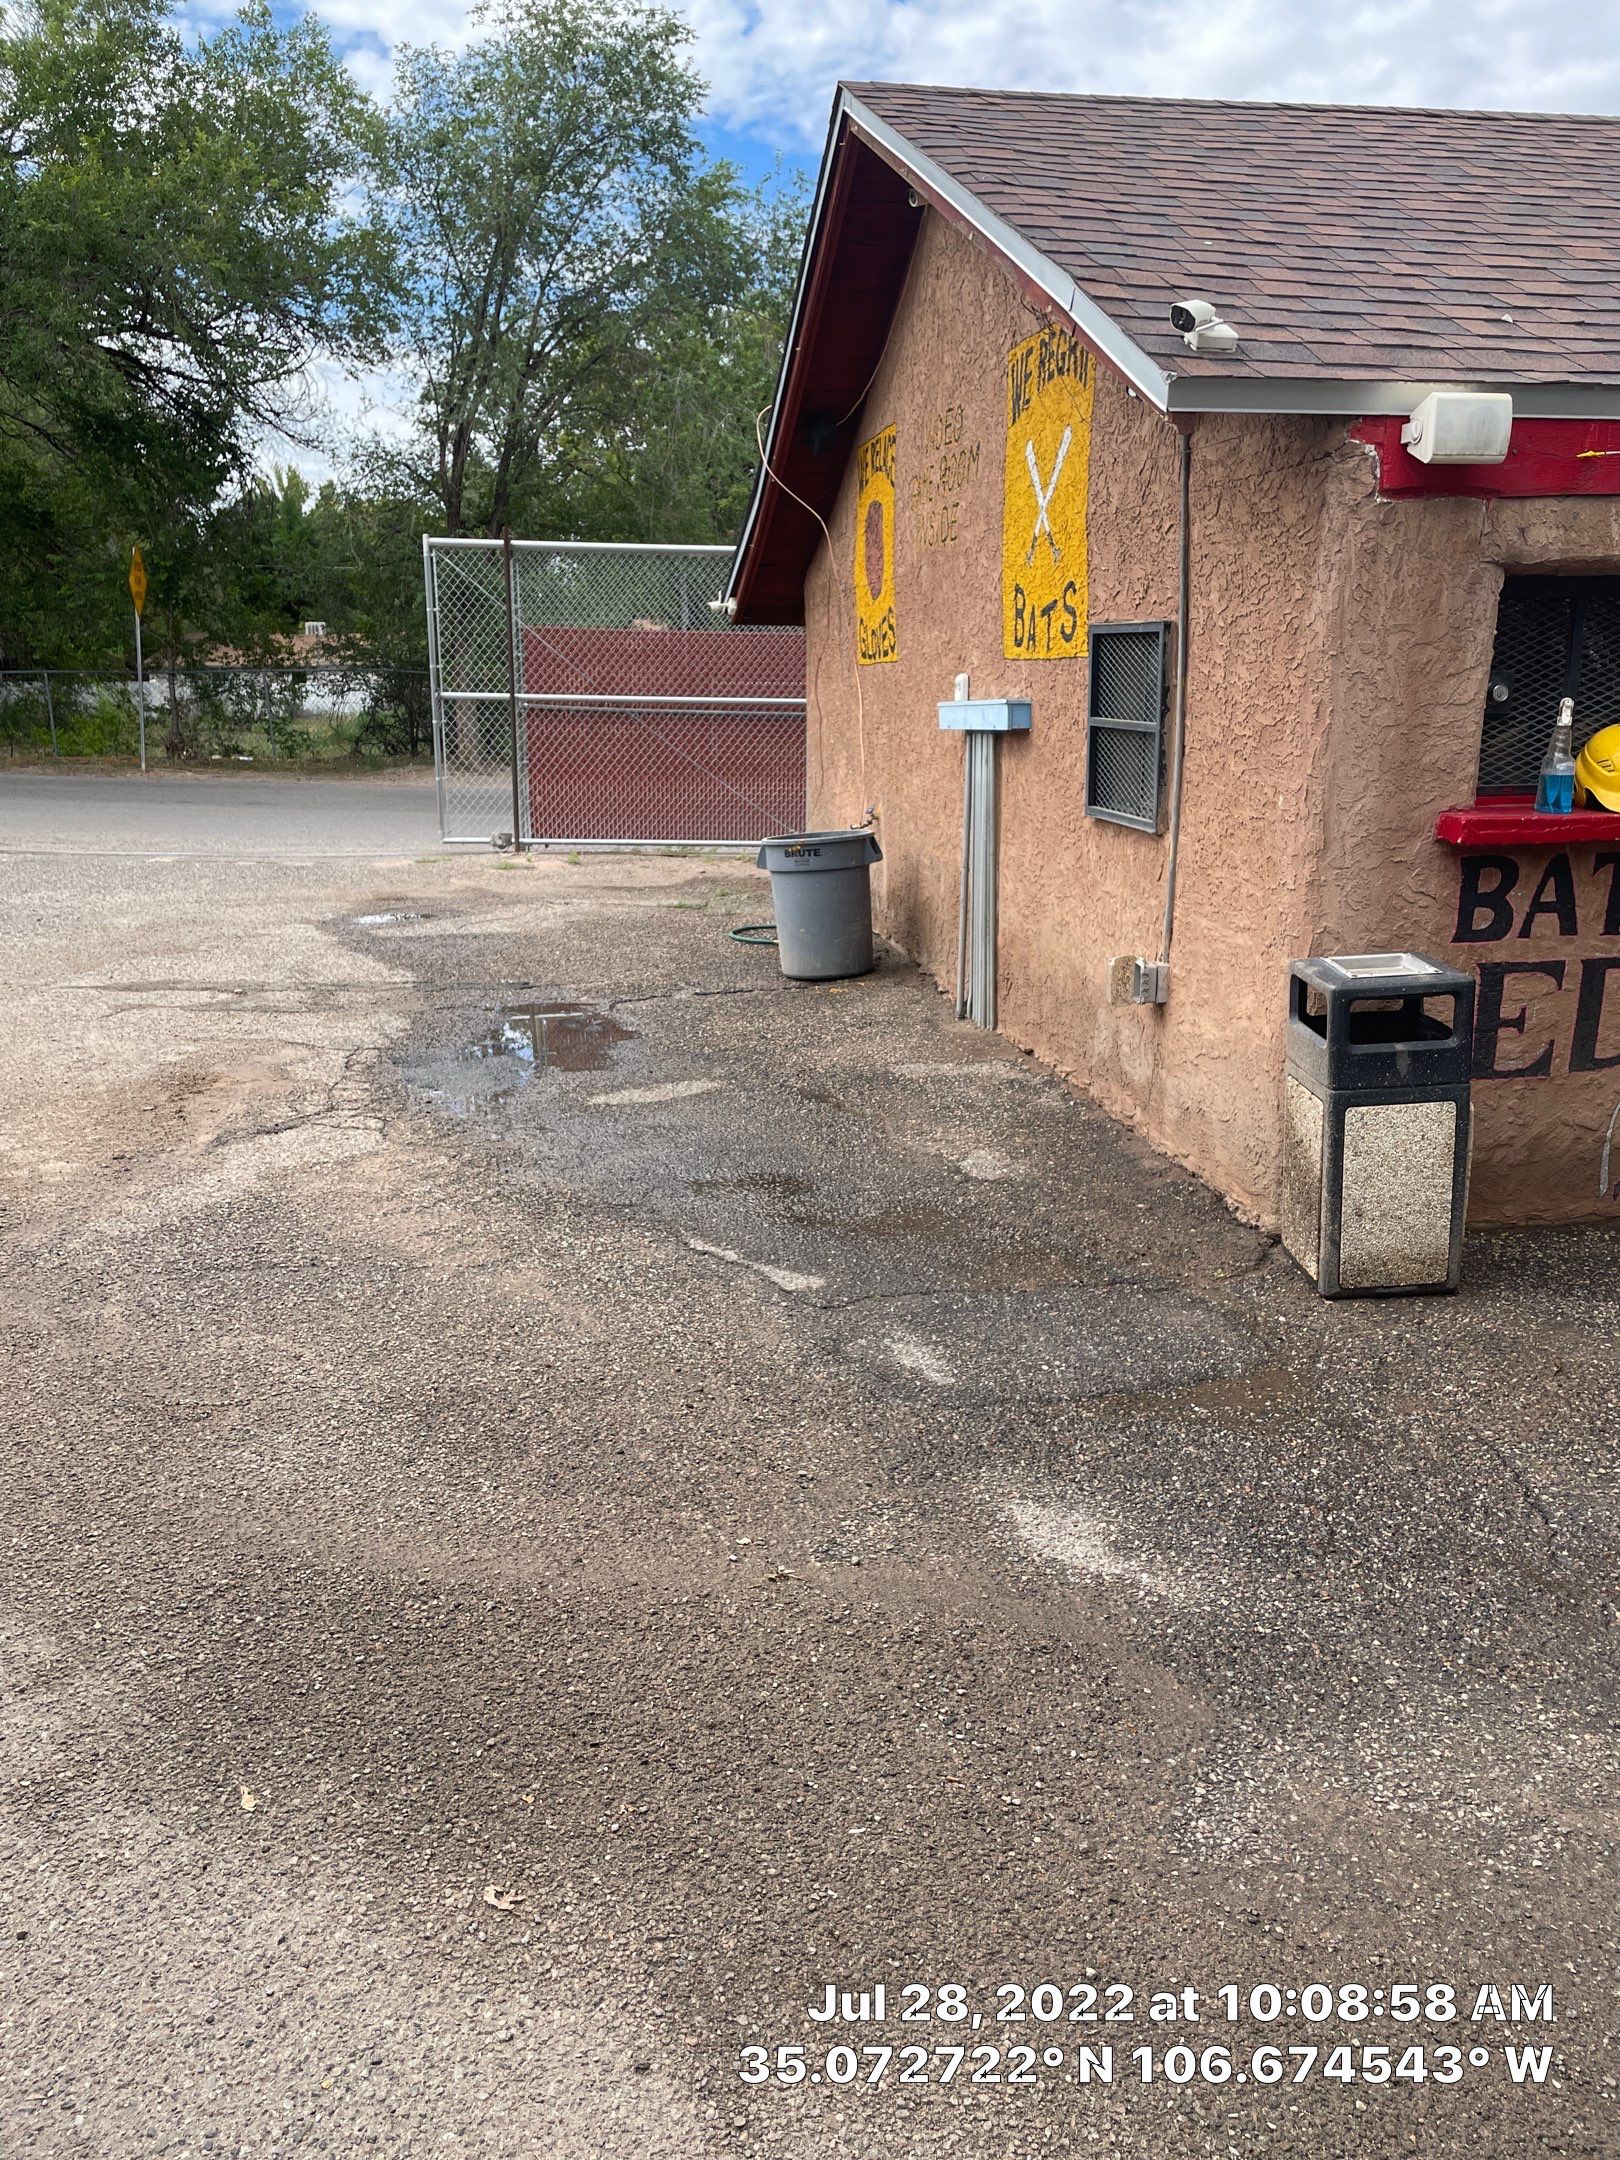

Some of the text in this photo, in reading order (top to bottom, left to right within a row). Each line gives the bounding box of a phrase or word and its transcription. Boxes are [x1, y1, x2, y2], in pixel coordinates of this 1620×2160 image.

[1011, 346, 1034, 426] WE
[937, 441, 980, 492] ROOM
[859, 606, 896, 660] GLOVES
[1014, 580, 1077, 653] BATS
